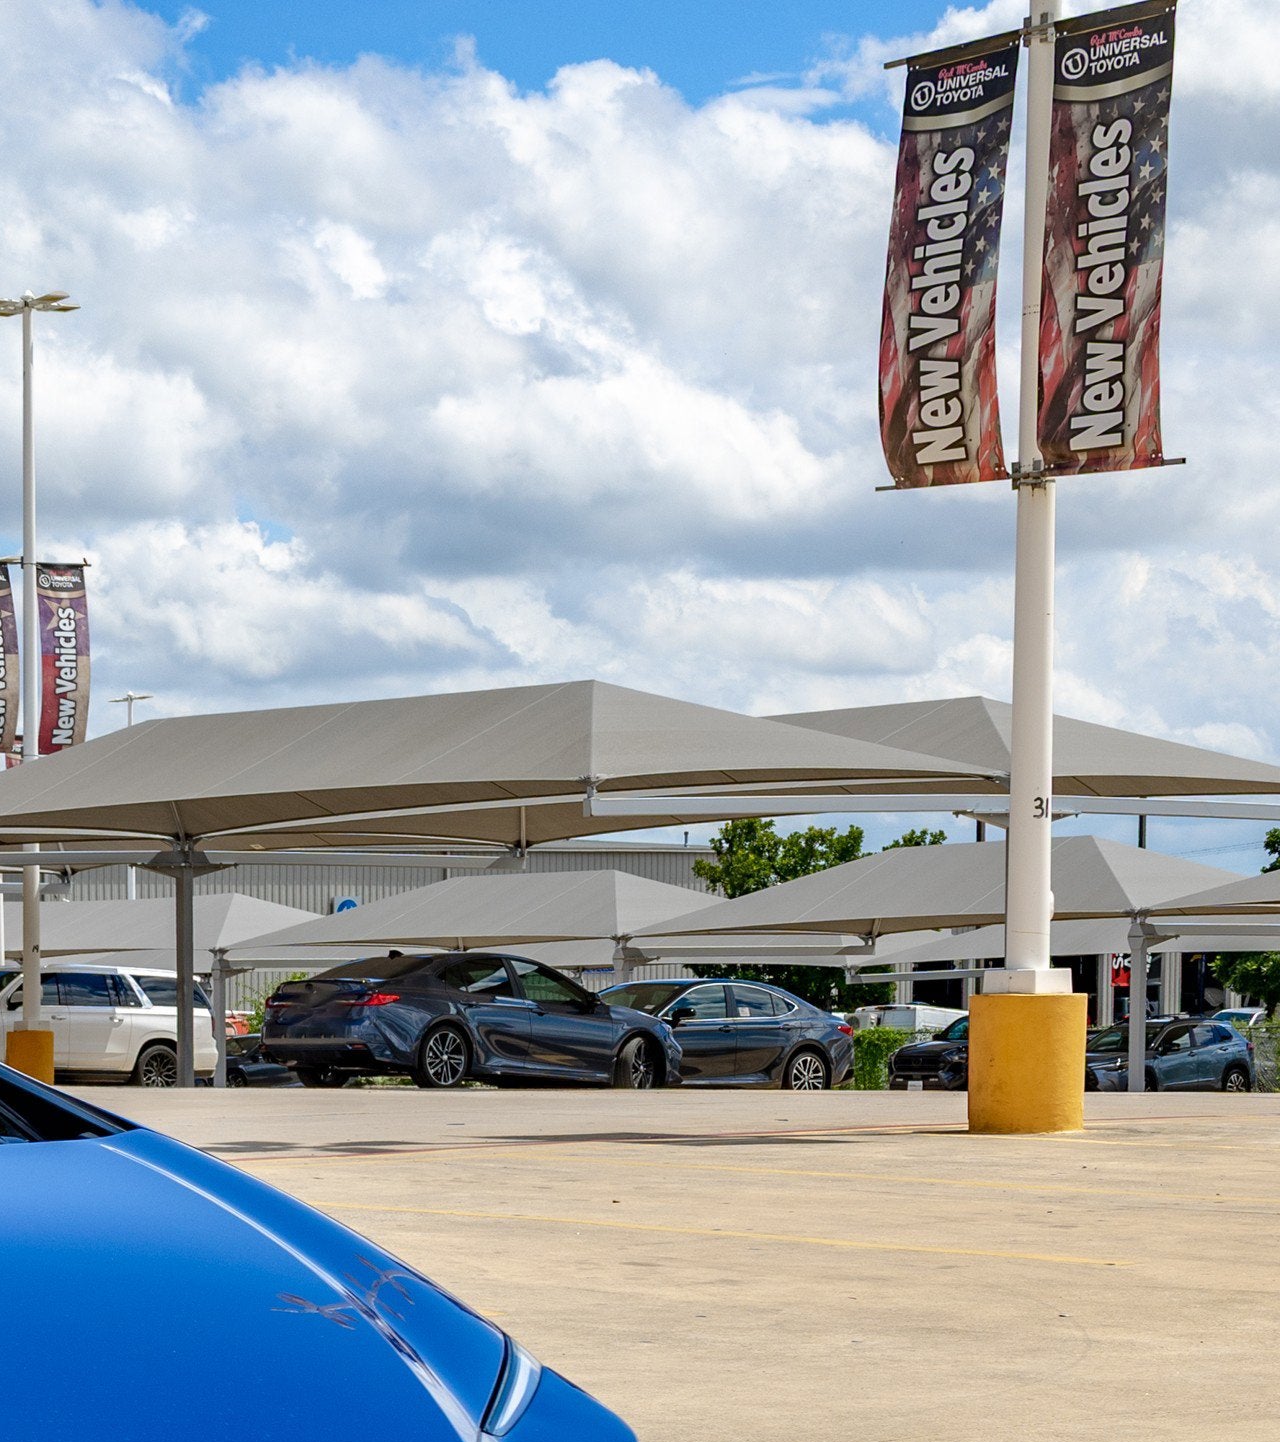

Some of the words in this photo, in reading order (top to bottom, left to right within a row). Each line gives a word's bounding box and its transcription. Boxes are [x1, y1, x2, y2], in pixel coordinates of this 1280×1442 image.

[1089, 52, 1140, 75] TOYOTA
[1090, 31, 1168, 60] UNIVERSAL
[935, 85, 984, 106] TOYOTA
[937, 64, 1009, 92] UNIVERSAL
[1075, 118, 1134, 333] Vehicles
[908, 146, 976, 353] Vehicles
[912, 358, 967, 466] New
[1068, 341, 1124, 451] New
[54, 607, 77, 695] Vehicles
[51, 701, 76, 745] New
[1033, 796, 1049, 819] 31
